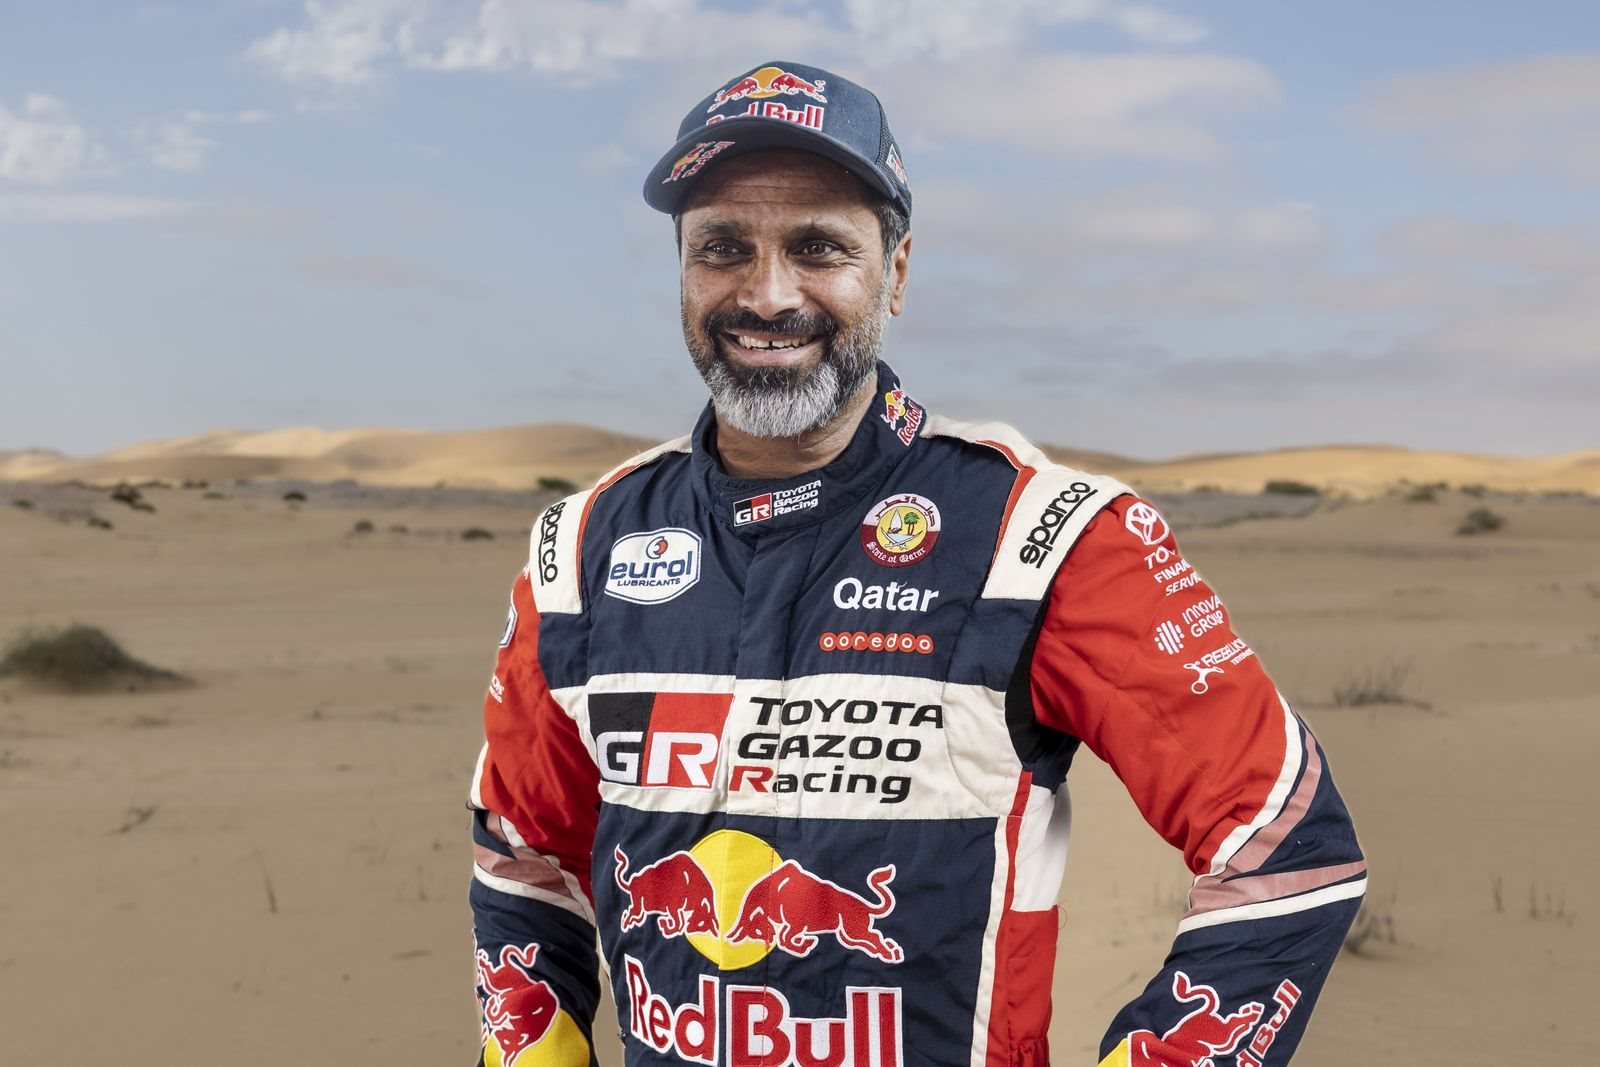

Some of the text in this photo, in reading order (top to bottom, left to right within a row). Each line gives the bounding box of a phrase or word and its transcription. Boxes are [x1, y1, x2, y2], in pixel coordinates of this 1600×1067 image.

[897, 415, 918, 446] Red
[773, 480, 822, 500] TOYOTA
[773, 489, 819, 508] GAZOO
[735, 503, 770, 525] GR
[773, 498, 819, 517] Racing
[1020, 482, 1091, 565] sparco
[541, 502, 567, 584] sparco
[866, 541, 926, 563] State of Qatar
[610, 551, 693, 580] eurol
[617, 578, 681, 587] LUBRICANTS
[833, 577, 940, 613] Qatar
[1190, 610, 1224, 638] GROUP
[821, 632, 932, 651] ooredoo
[749, 696, 945, 729] TOYOTA
[596, 731, 719, 786] GR
[737, 732, 923, 762] GAZOO
[729, 764, 912, 804] Racing
[624, 954, 905, 1067] Red Bull
[1249, 979, 1302, 1060] Bull
